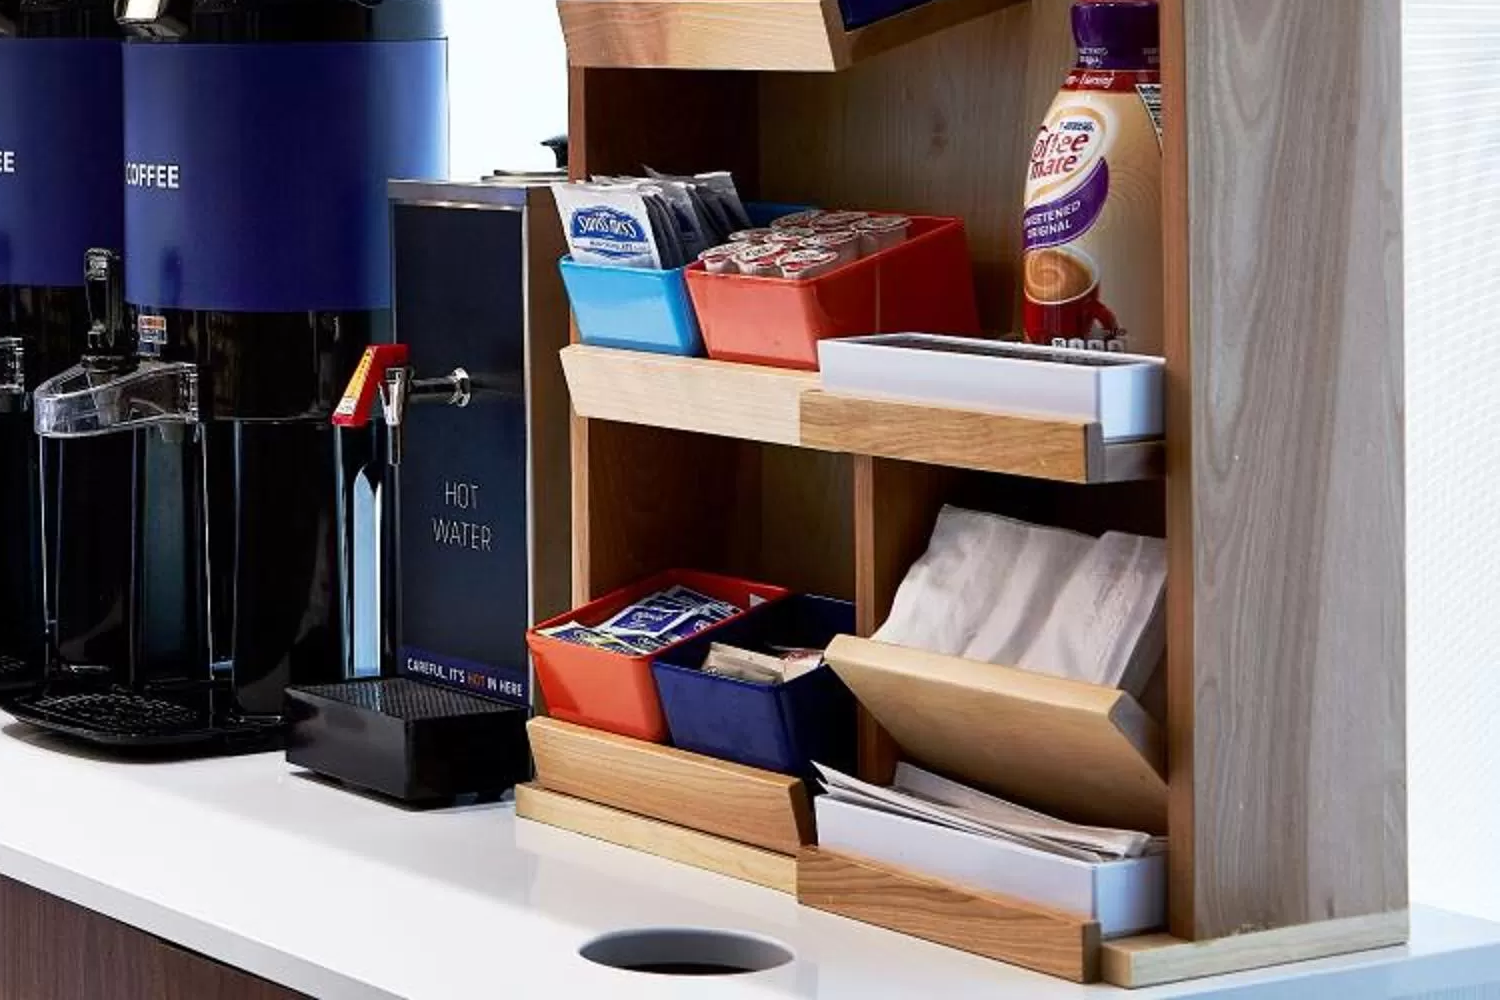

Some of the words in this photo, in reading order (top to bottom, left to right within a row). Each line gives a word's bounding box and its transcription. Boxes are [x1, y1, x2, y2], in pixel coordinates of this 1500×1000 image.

[126, 162, 179, 189] COFFEE
[445, 480, 479, 509] HOT
[432, 517, 492, 552] WATER
[487, 676, 497, 691] IN
[499, 679, 523, 697] HERE
